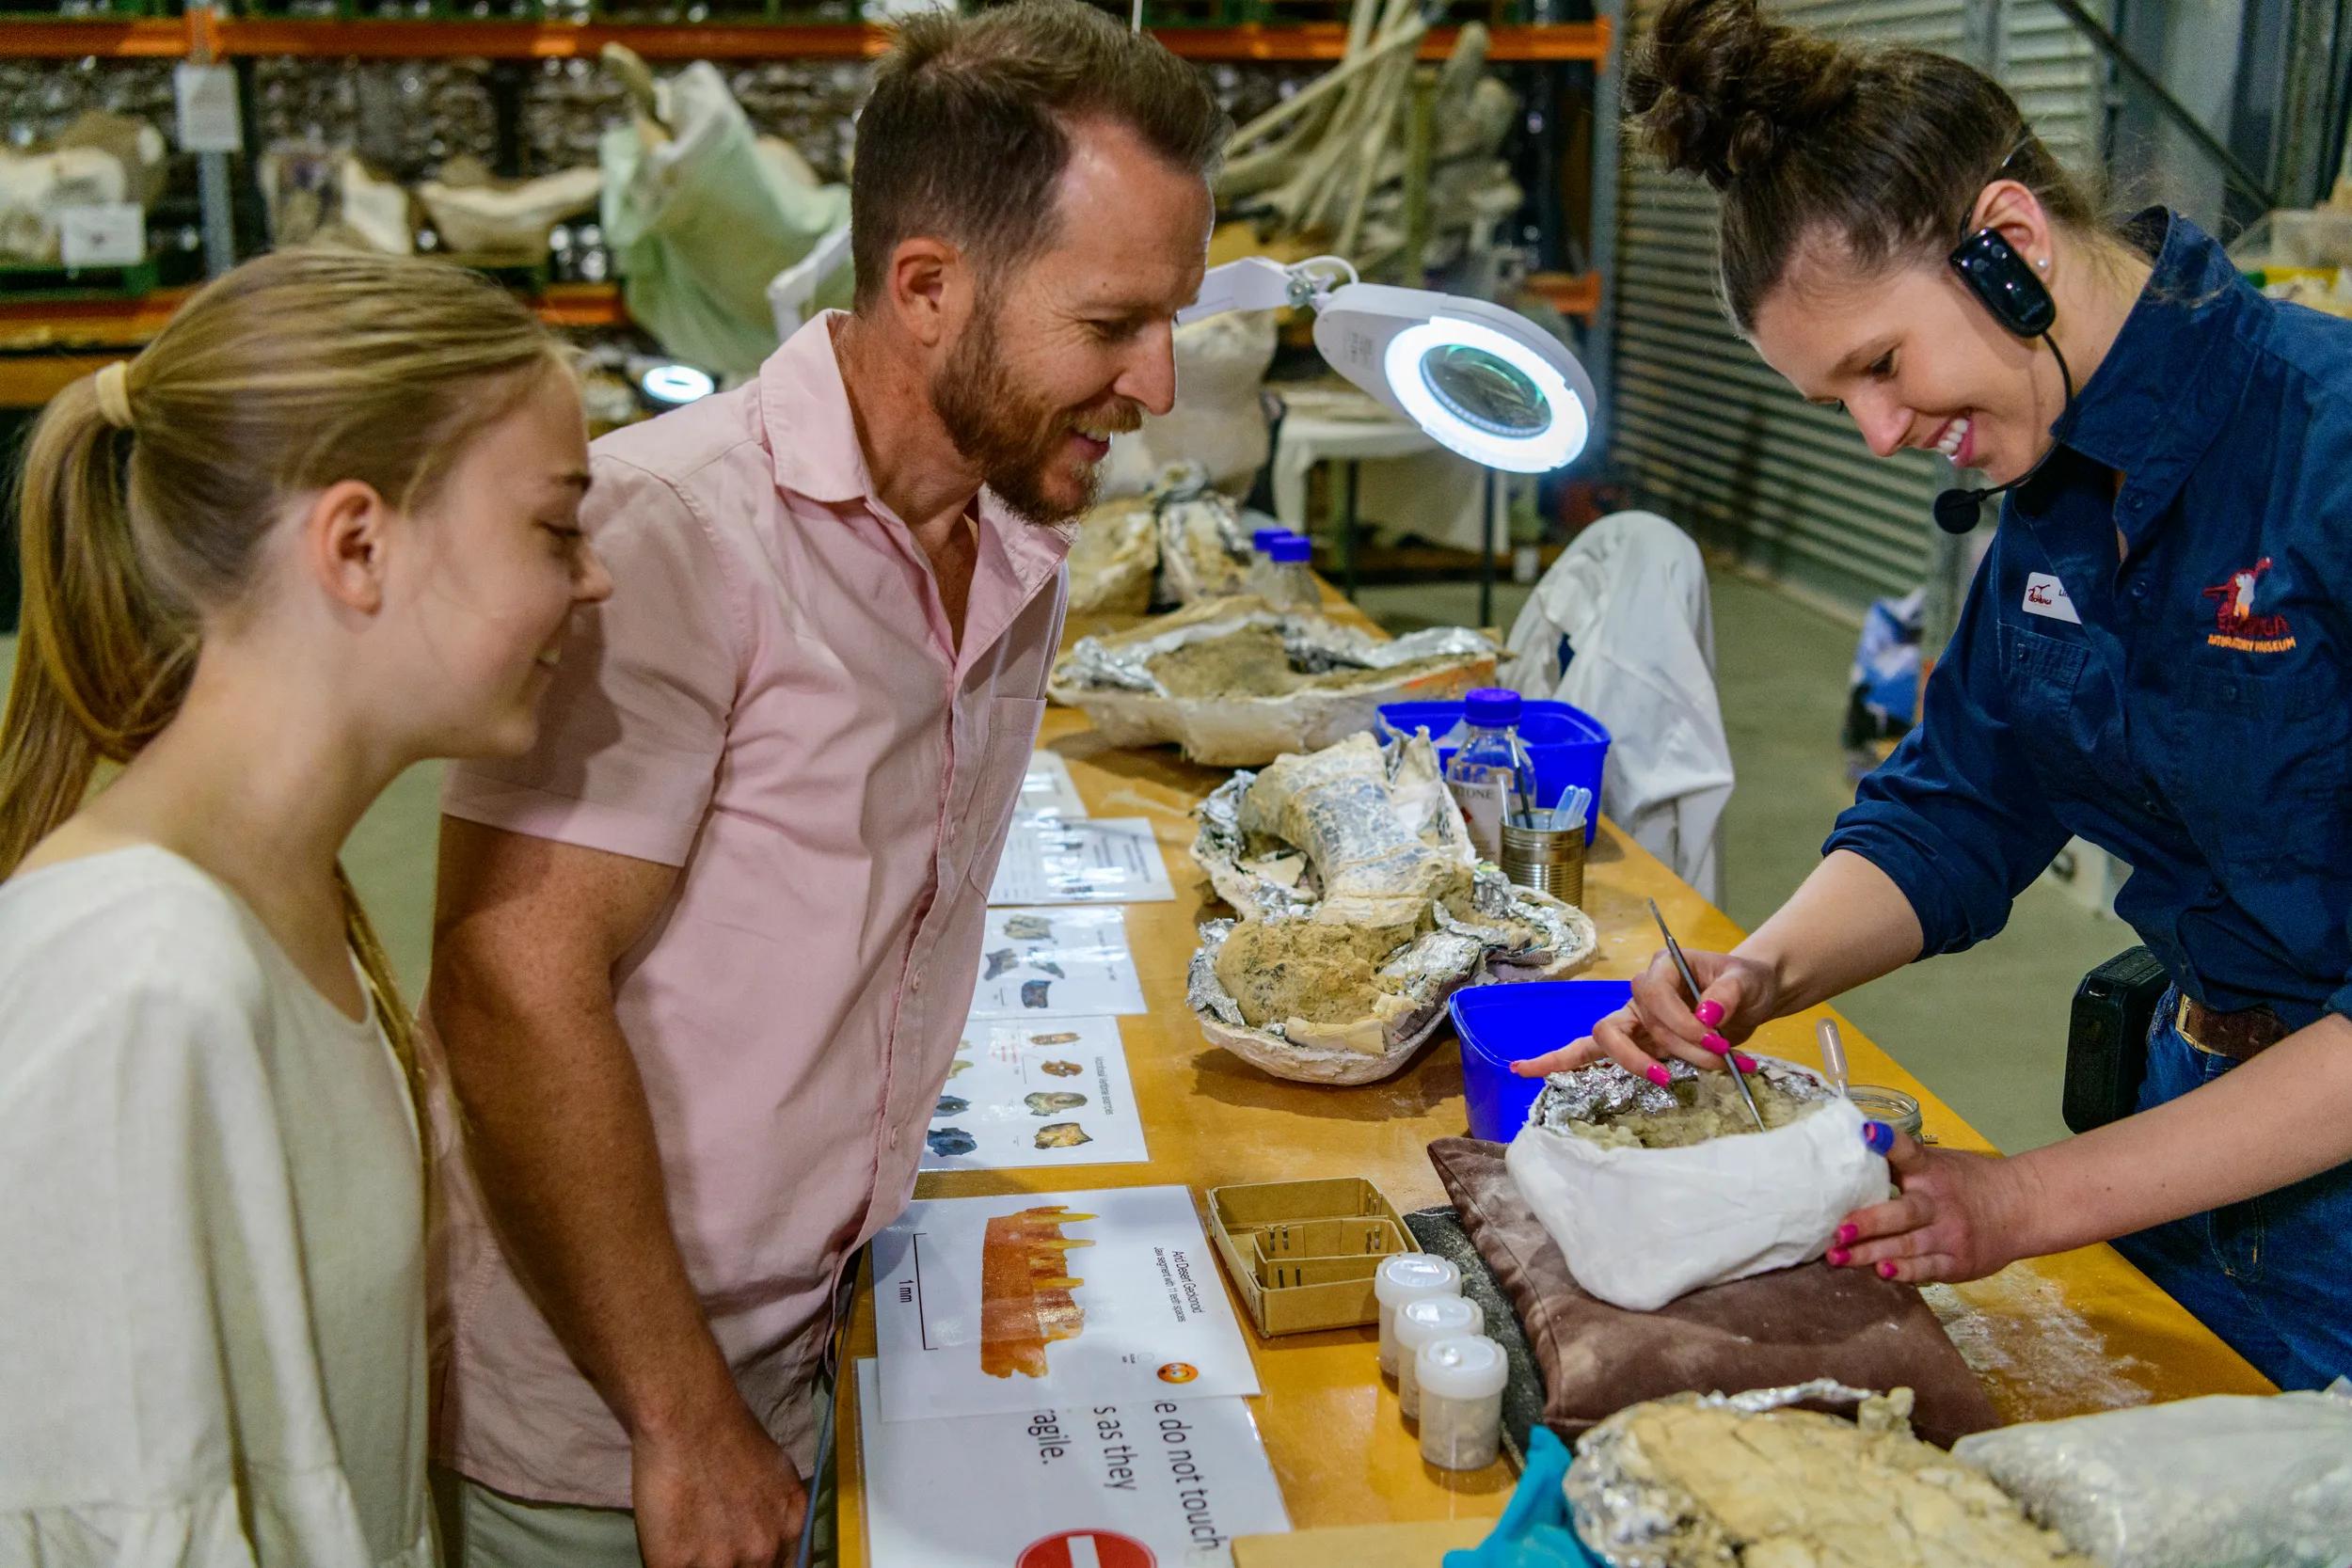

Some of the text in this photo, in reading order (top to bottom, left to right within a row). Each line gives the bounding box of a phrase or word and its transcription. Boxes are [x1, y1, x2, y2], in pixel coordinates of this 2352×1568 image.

[1153, 1245, 1165, 1257] Jaw
[1171, 1249, 1188, 1263] Arid
[1155, 1257, 1173, 1278] segment
[1176, 1262, 1194, 1283] Desert
[899, 1287, 913, 1303] mm
[1092, 1405, 1139, 1492] s as they
[1153, 1400, 1229, 1552] e do not touch
